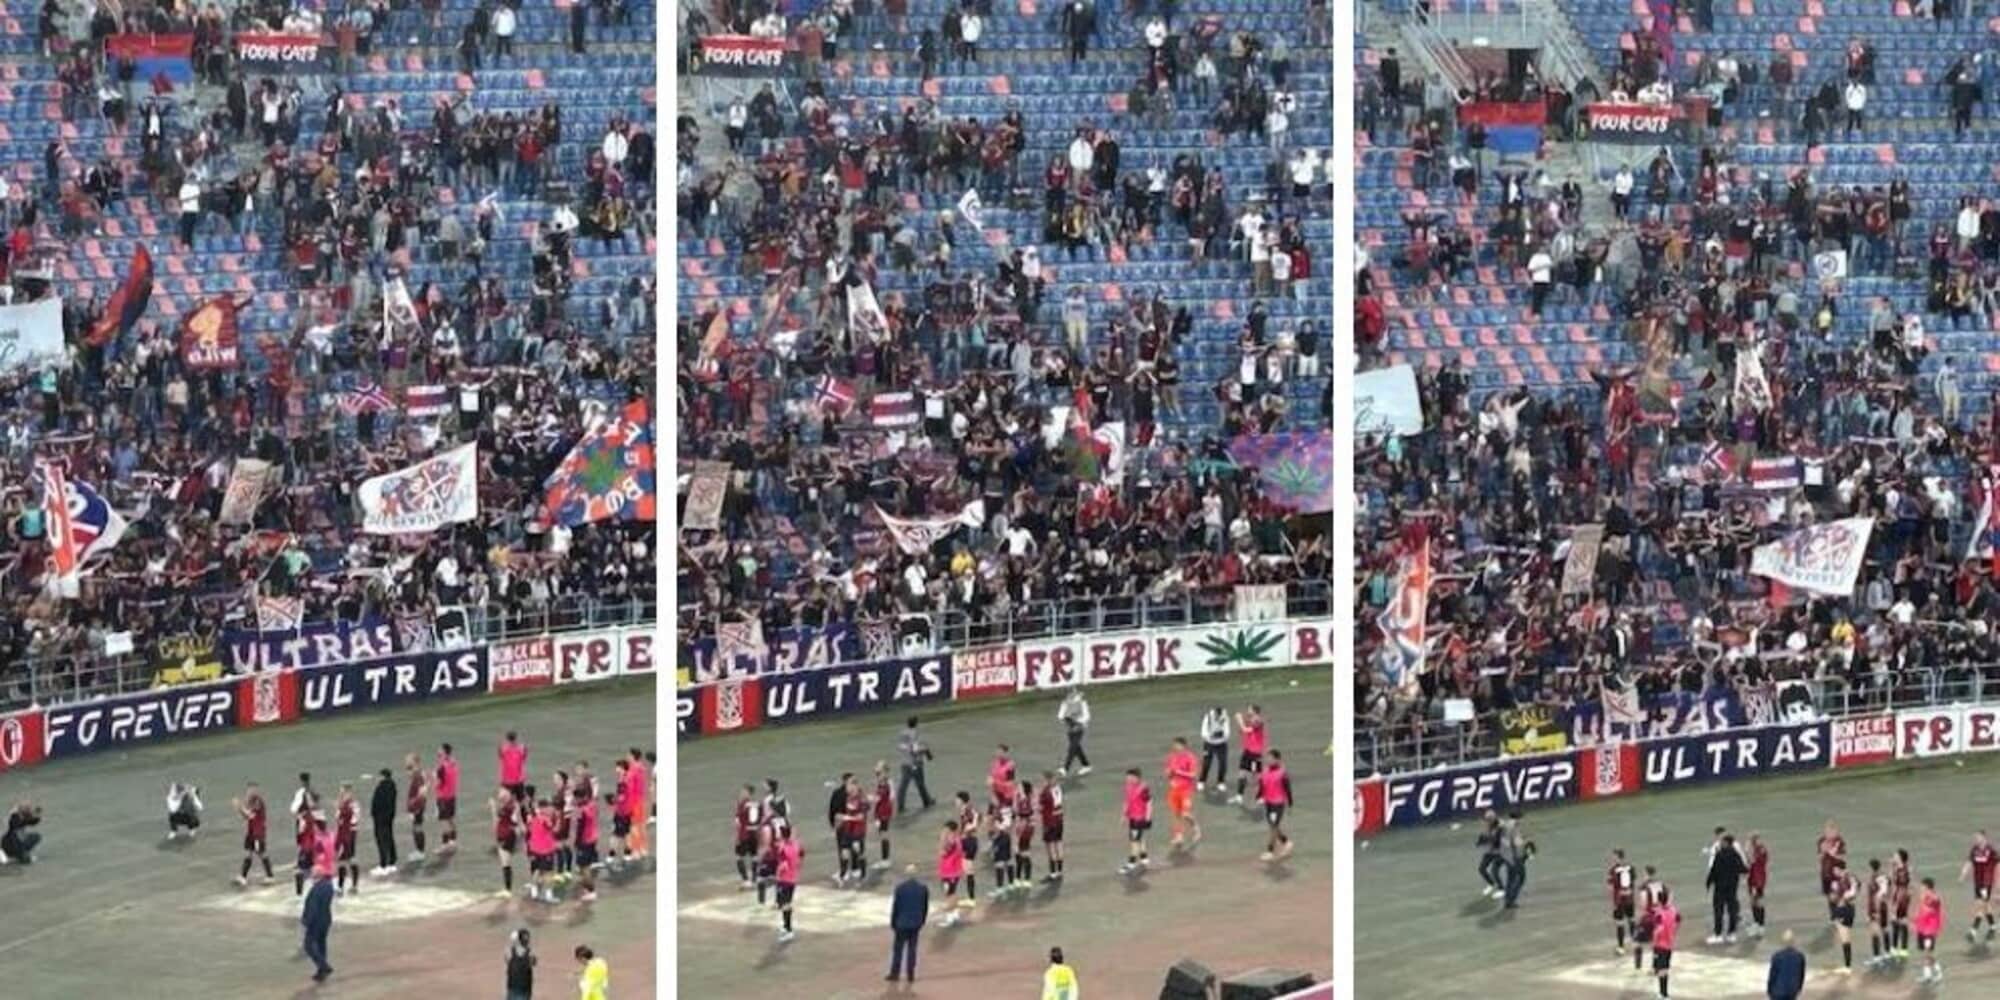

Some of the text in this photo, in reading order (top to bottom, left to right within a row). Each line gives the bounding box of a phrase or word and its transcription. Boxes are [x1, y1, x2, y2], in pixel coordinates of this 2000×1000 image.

[241, 44, 318, 62] FOUR CATS
[704, 46, 782, 66] FOUR CATS
[1591, 114, 1669, 133] FOUR CATS
[232, 625, 393, 674] ULTRAS
[1024, 637, 1181, 687] FREAK
[1296, 627, 1333, 661] B
[304, 653, 478, 710] ULTRAS
[767, 661, 941, 717] ULTRAS
[45, 692, 232, 756] FOREVER
[1904, 712, 2000, 754] FRE
[1646, 728, 1820, 782] ULTRAS
[1384, 761, 1573, 825] FOREVER
